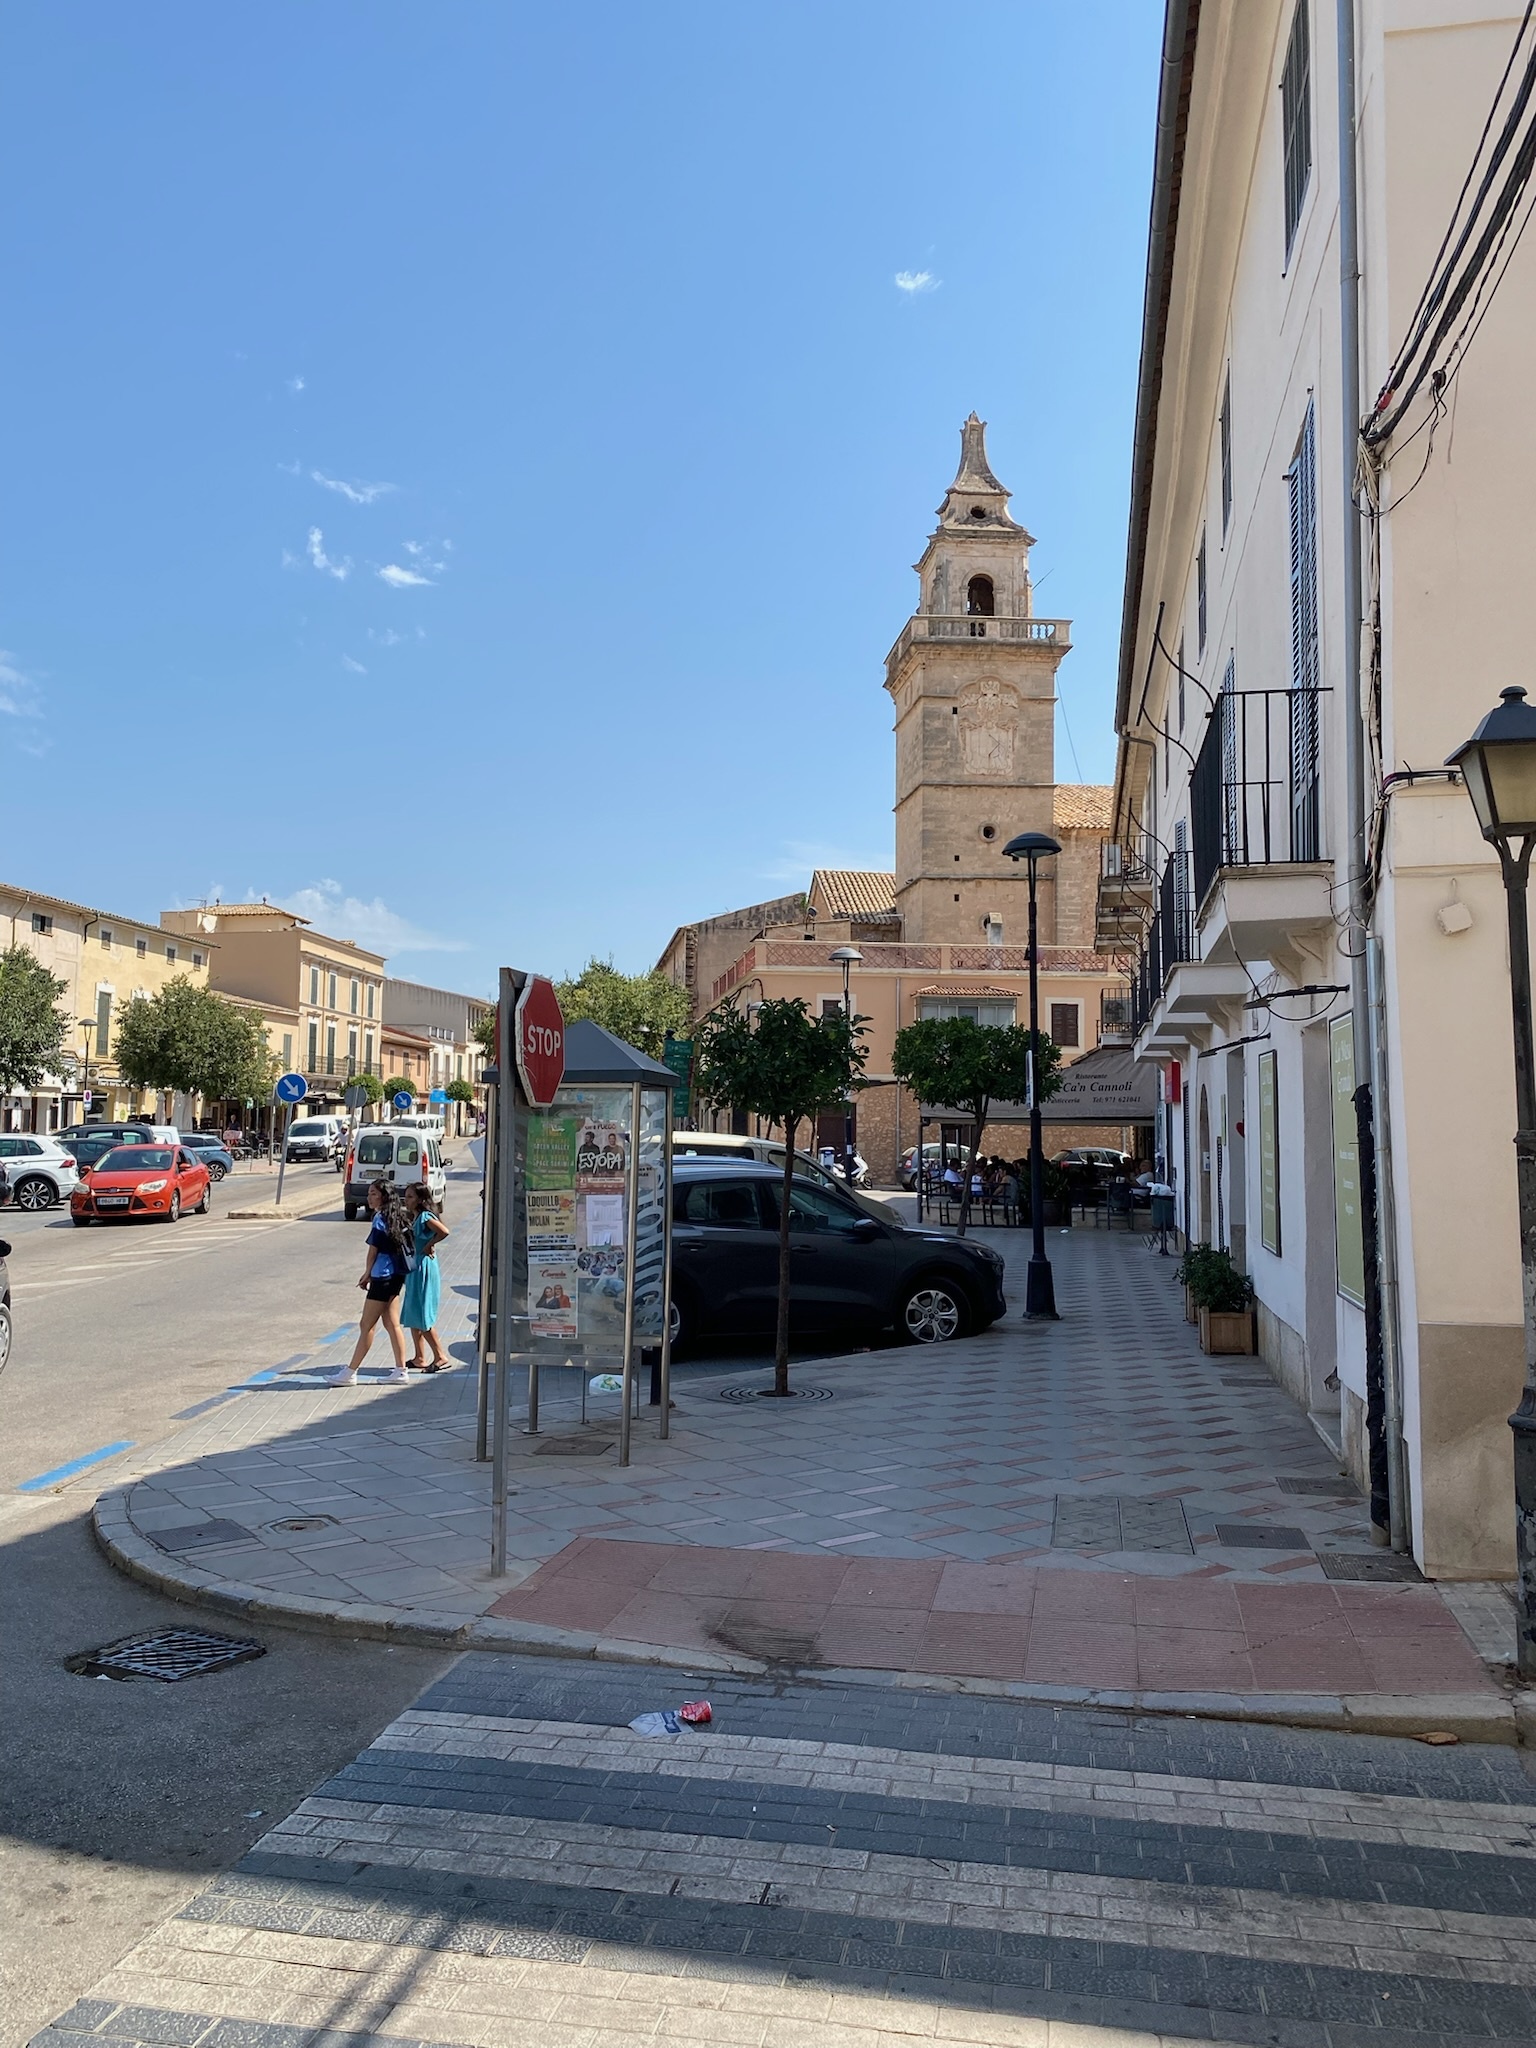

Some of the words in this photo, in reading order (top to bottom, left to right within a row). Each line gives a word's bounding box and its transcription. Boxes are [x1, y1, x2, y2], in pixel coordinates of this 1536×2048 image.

[527, 1024, 562, 1058] STOP
[1063, 1082, 1086, 1093] Ca'n
[1090, 1081, 1133, 1092] Cannoli
[578, 1151, 622, 1174] ESTOPA
[527, 1195, 560, 1208] LOQUILLO
